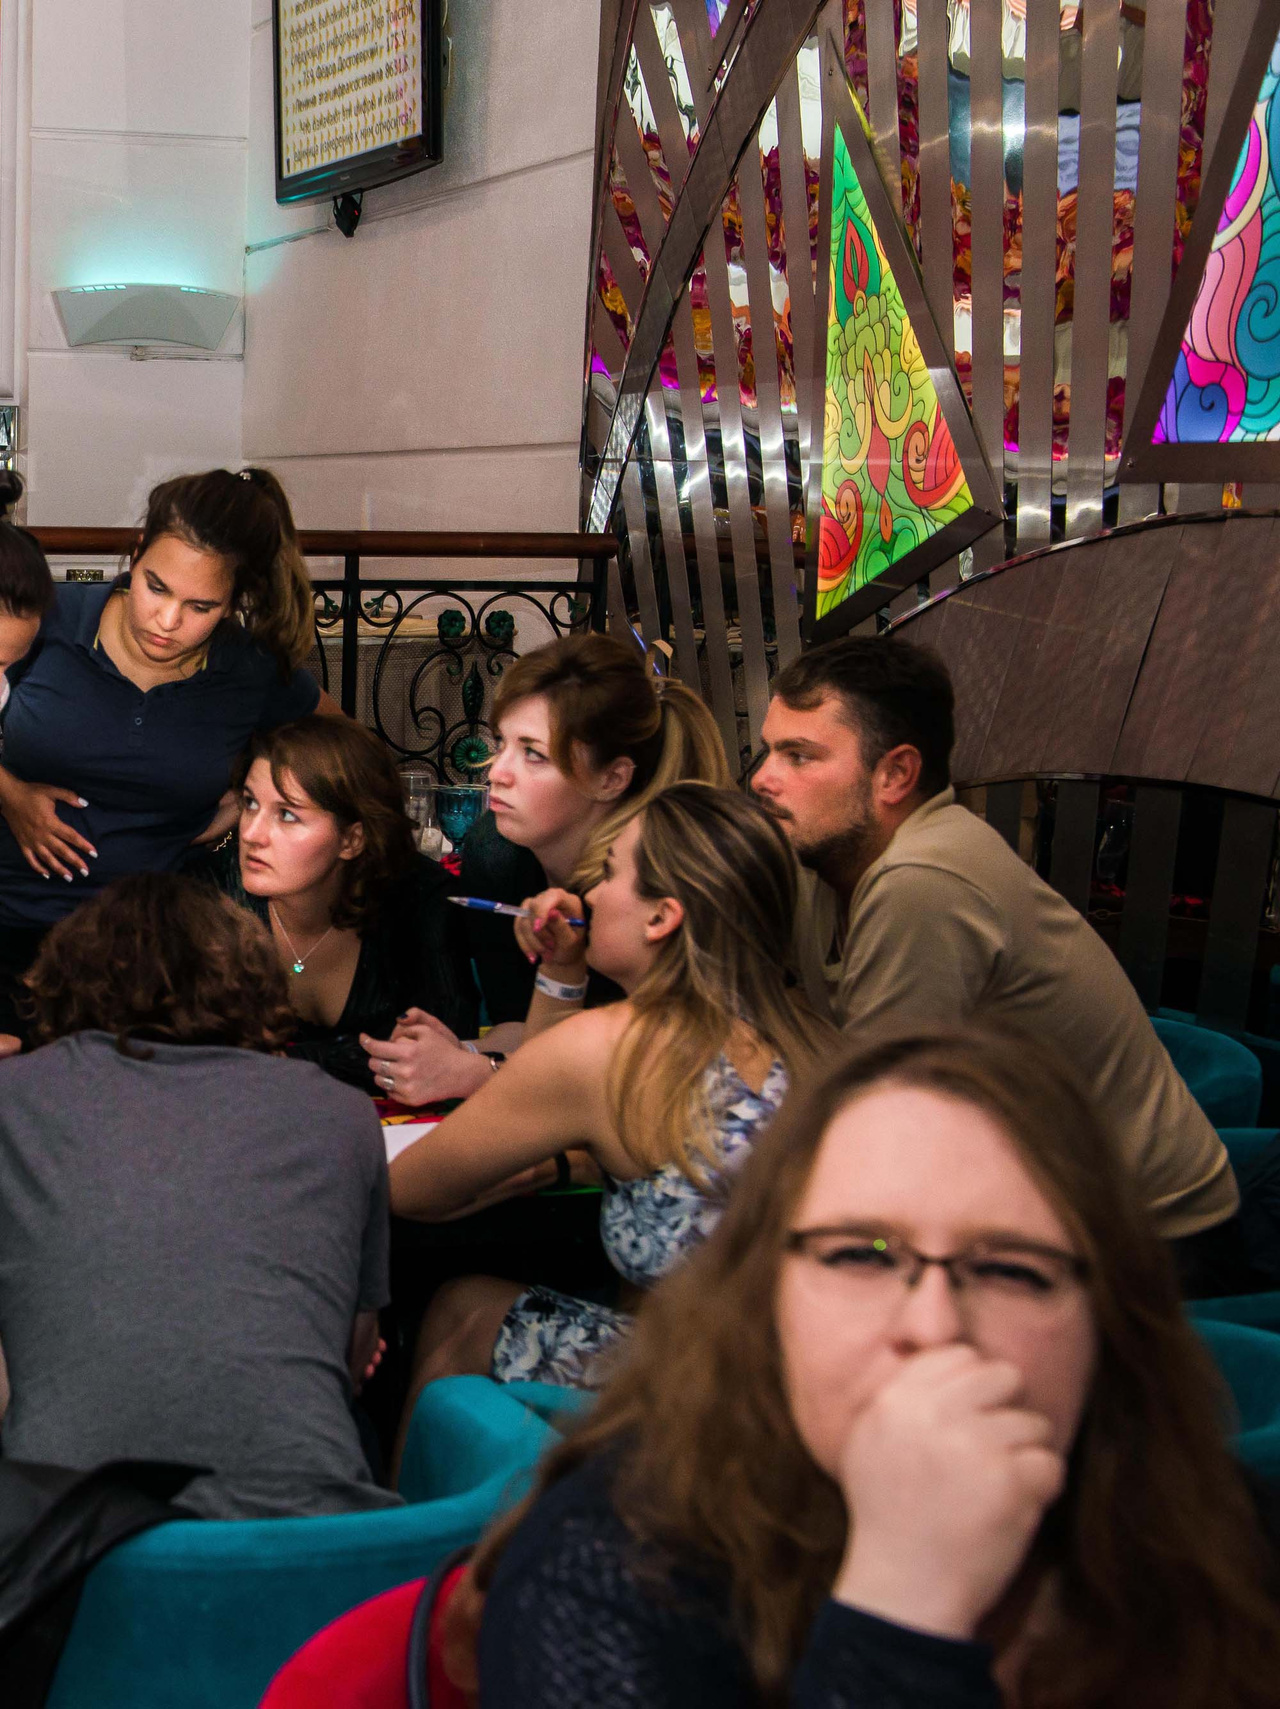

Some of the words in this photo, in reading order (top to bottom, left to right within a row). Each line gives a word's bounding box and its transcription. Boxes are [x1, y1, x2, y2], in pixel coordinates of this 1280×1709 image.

[372, 15, 384, 32] Лев
[386, 4, 413, 25] Толстой
[338, 43, 379, 73] Достоевский
[384, 88, 403, 104] какая
[360, 126, 373, 139] ним
[375, 107, 413, 134] относится?
